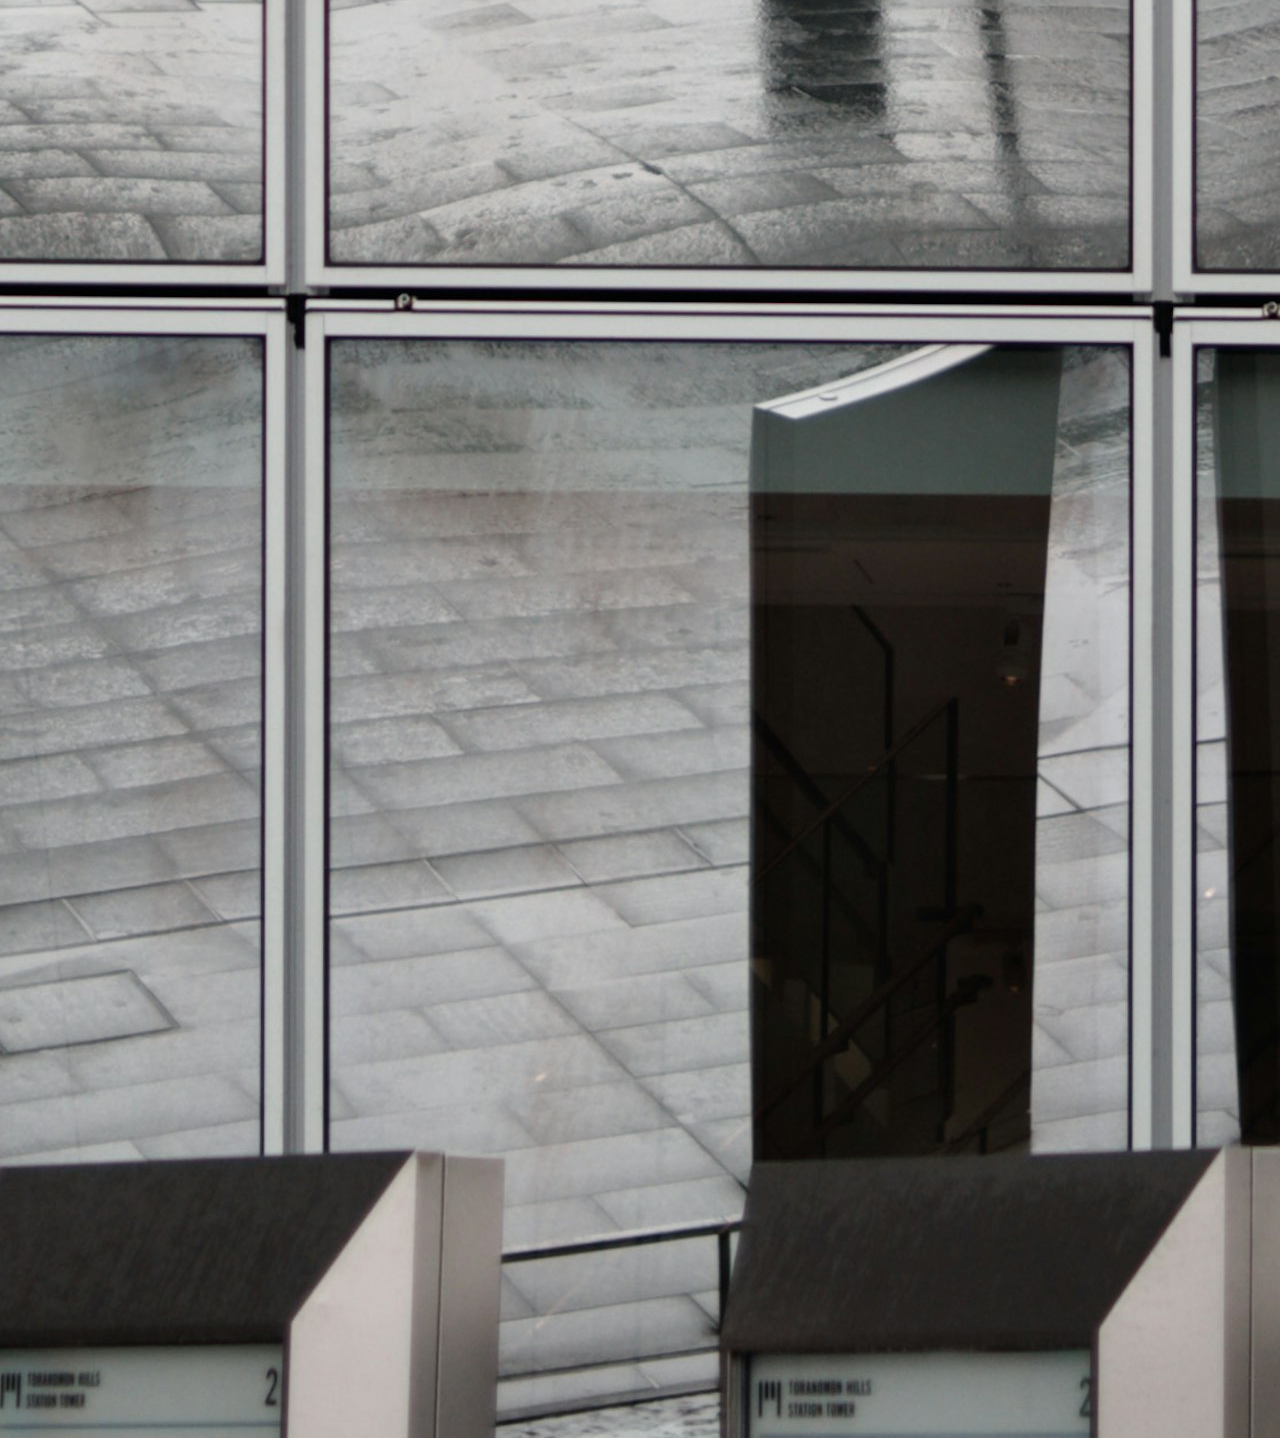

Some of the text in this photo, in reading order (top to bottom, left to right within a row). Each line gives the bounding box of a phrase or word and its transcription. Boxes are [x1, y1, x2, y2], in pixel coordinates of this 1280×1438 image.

[27, 1370, 101, 1387] TORANOMON HILLS
[265, 1367, 278, 1407] 2
[788, 1379, 872, 1397] TORANOMON HILLS
[26, 1393, 86, 1409] STATION TOWER
[788, 1402, 855, 1418] STATION TOWER
